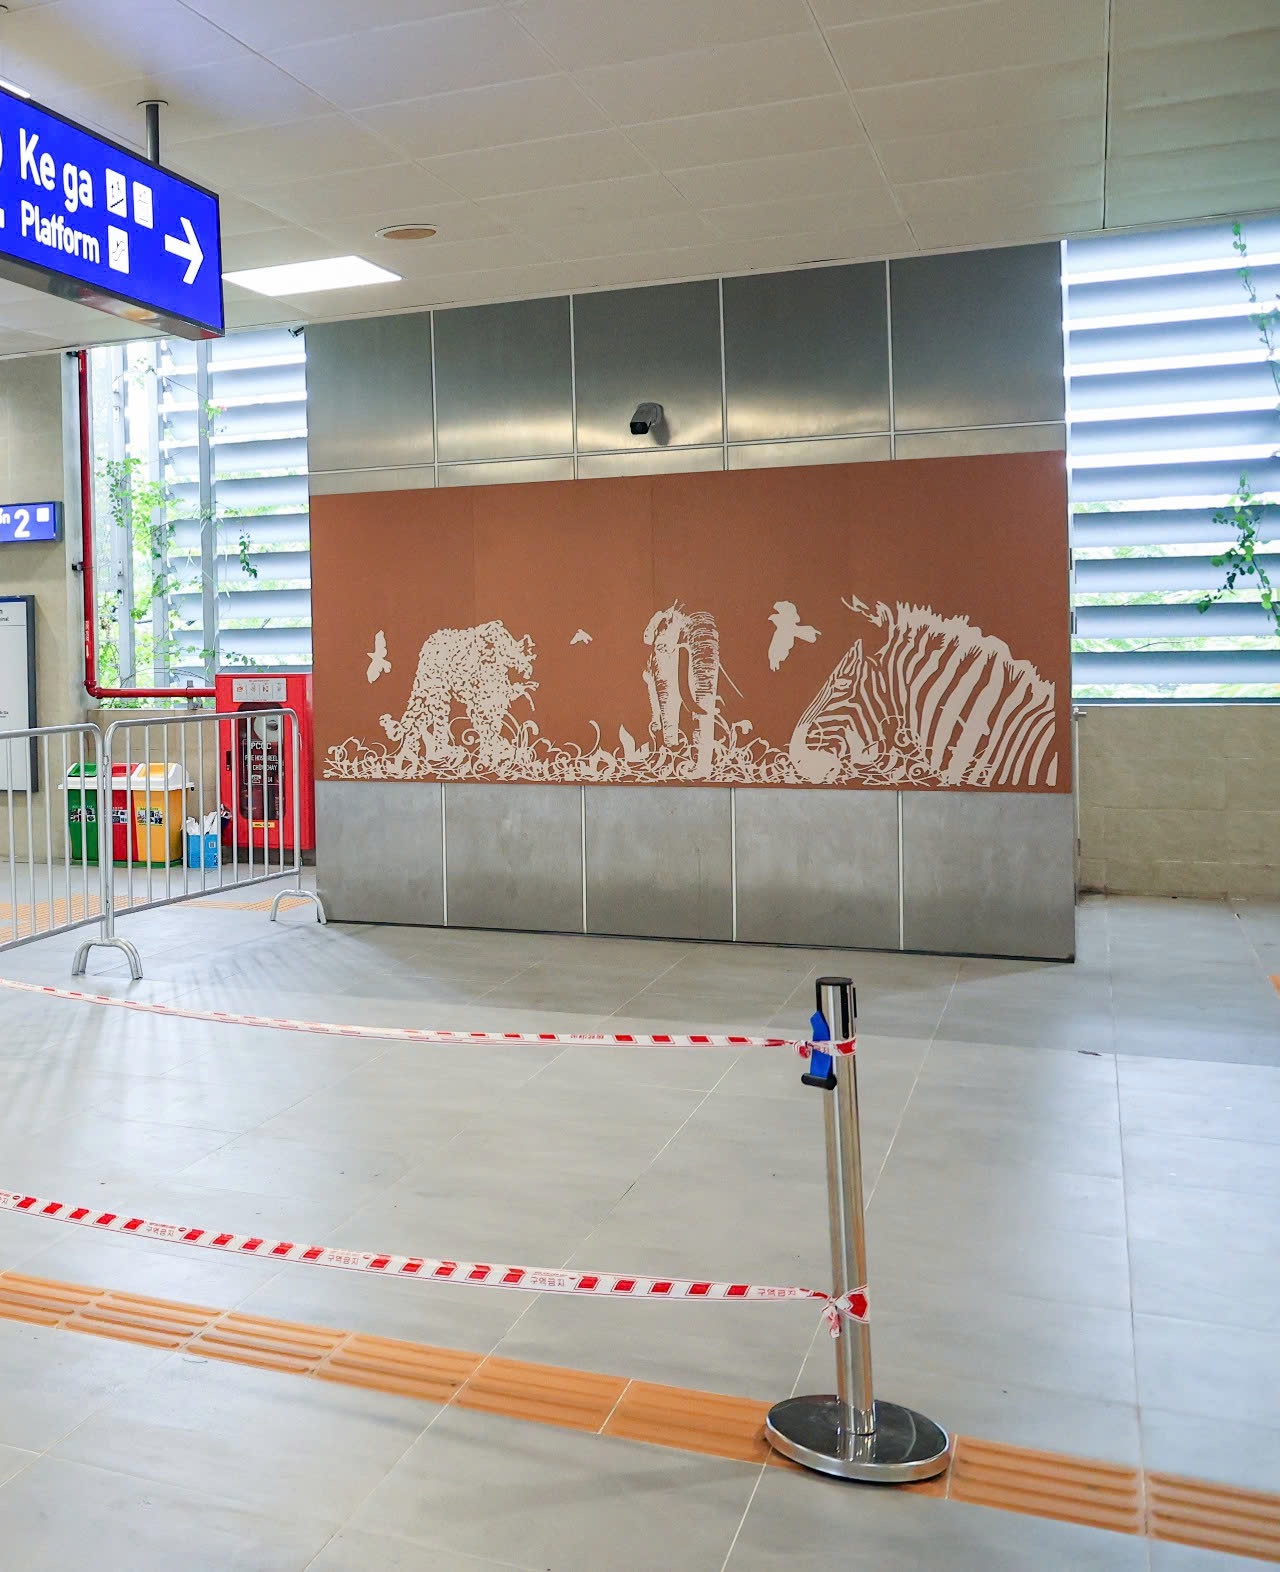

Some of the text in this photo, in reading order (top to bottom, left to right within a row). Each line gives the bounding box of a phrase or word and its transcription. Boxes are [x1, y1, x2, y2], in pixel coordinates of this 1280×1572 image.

[19, 128, 94, 213] Ke ga
[20, 200, 100, 264] Platform
[14, 508, 30, 538] 2
